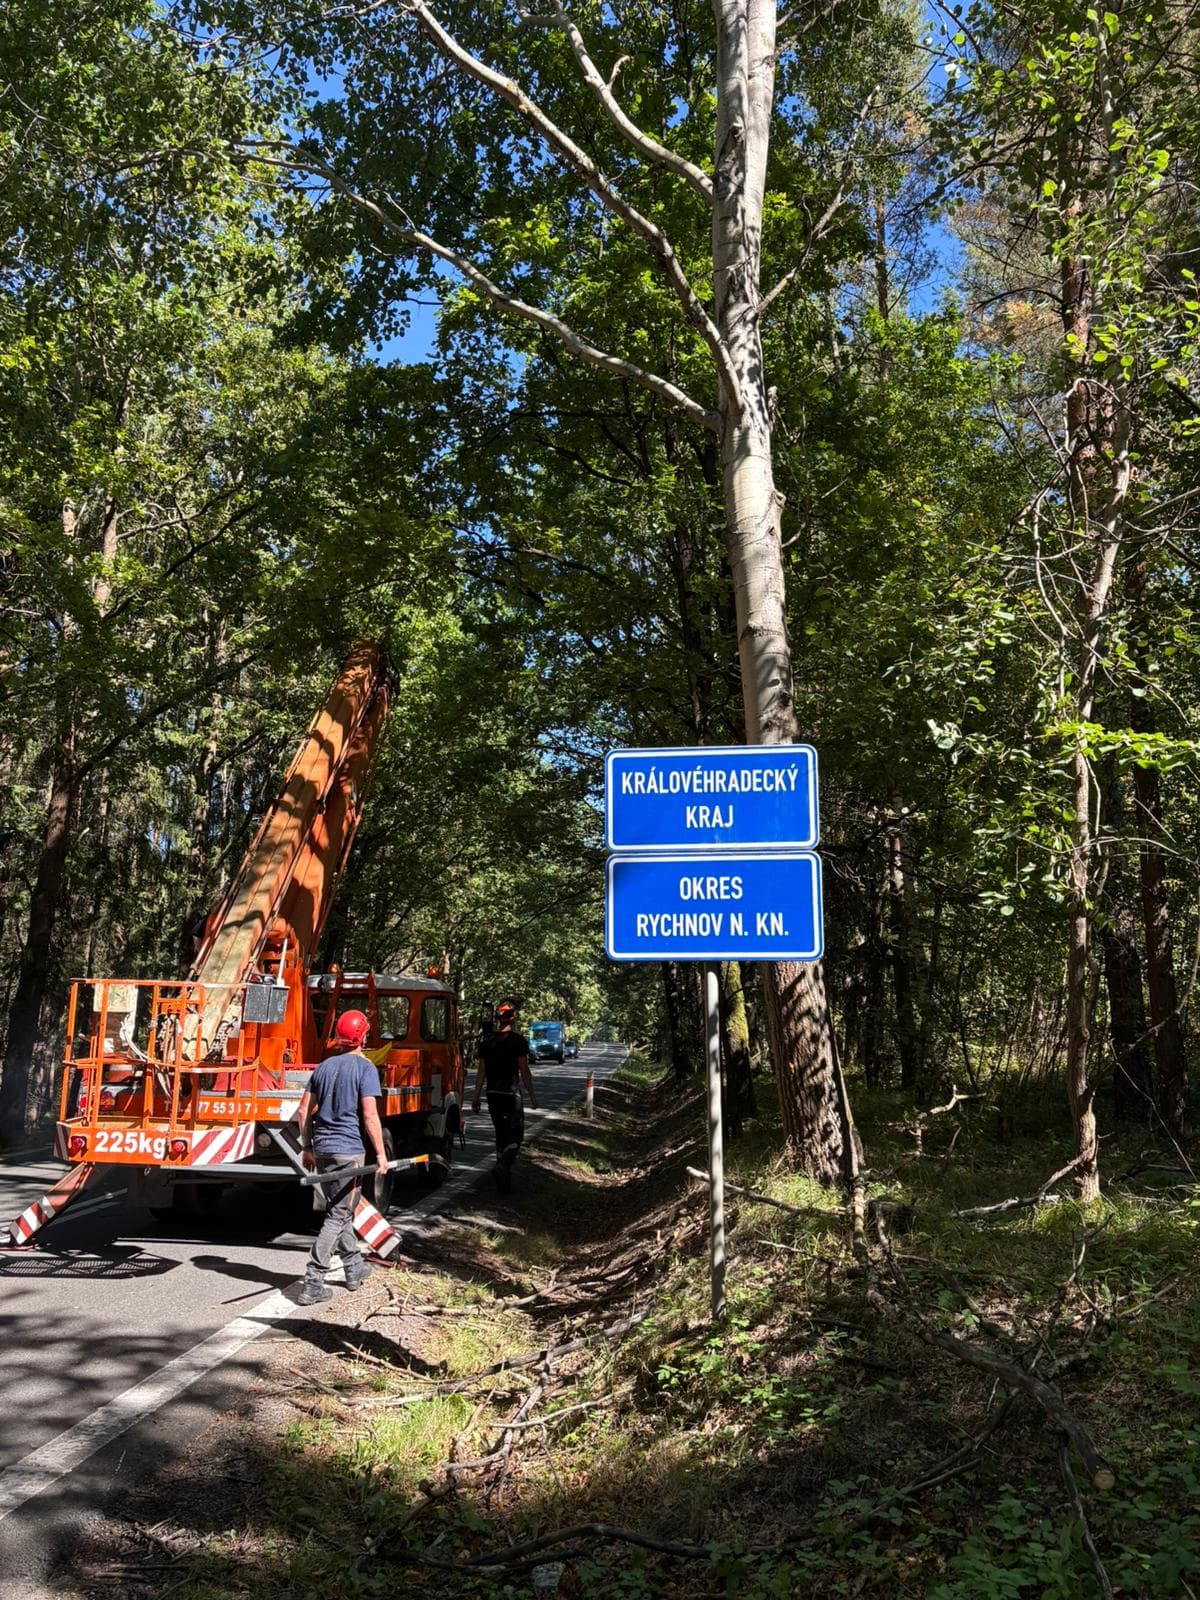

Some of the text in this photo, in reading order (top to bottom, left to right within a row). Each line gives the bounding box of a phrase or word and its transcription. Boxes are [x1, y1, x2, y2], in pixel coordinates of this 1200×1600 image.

[621, 763, 798, 794] KRÁLOVÉHRADECKÝ
[685, 805, 734, 829] KRAJ
[679, 876, 744, 900] OKRES
[636, 912, 789, 937] RYCHNOV N. KN.
[94, 1131, 167, 1160] 225kg
